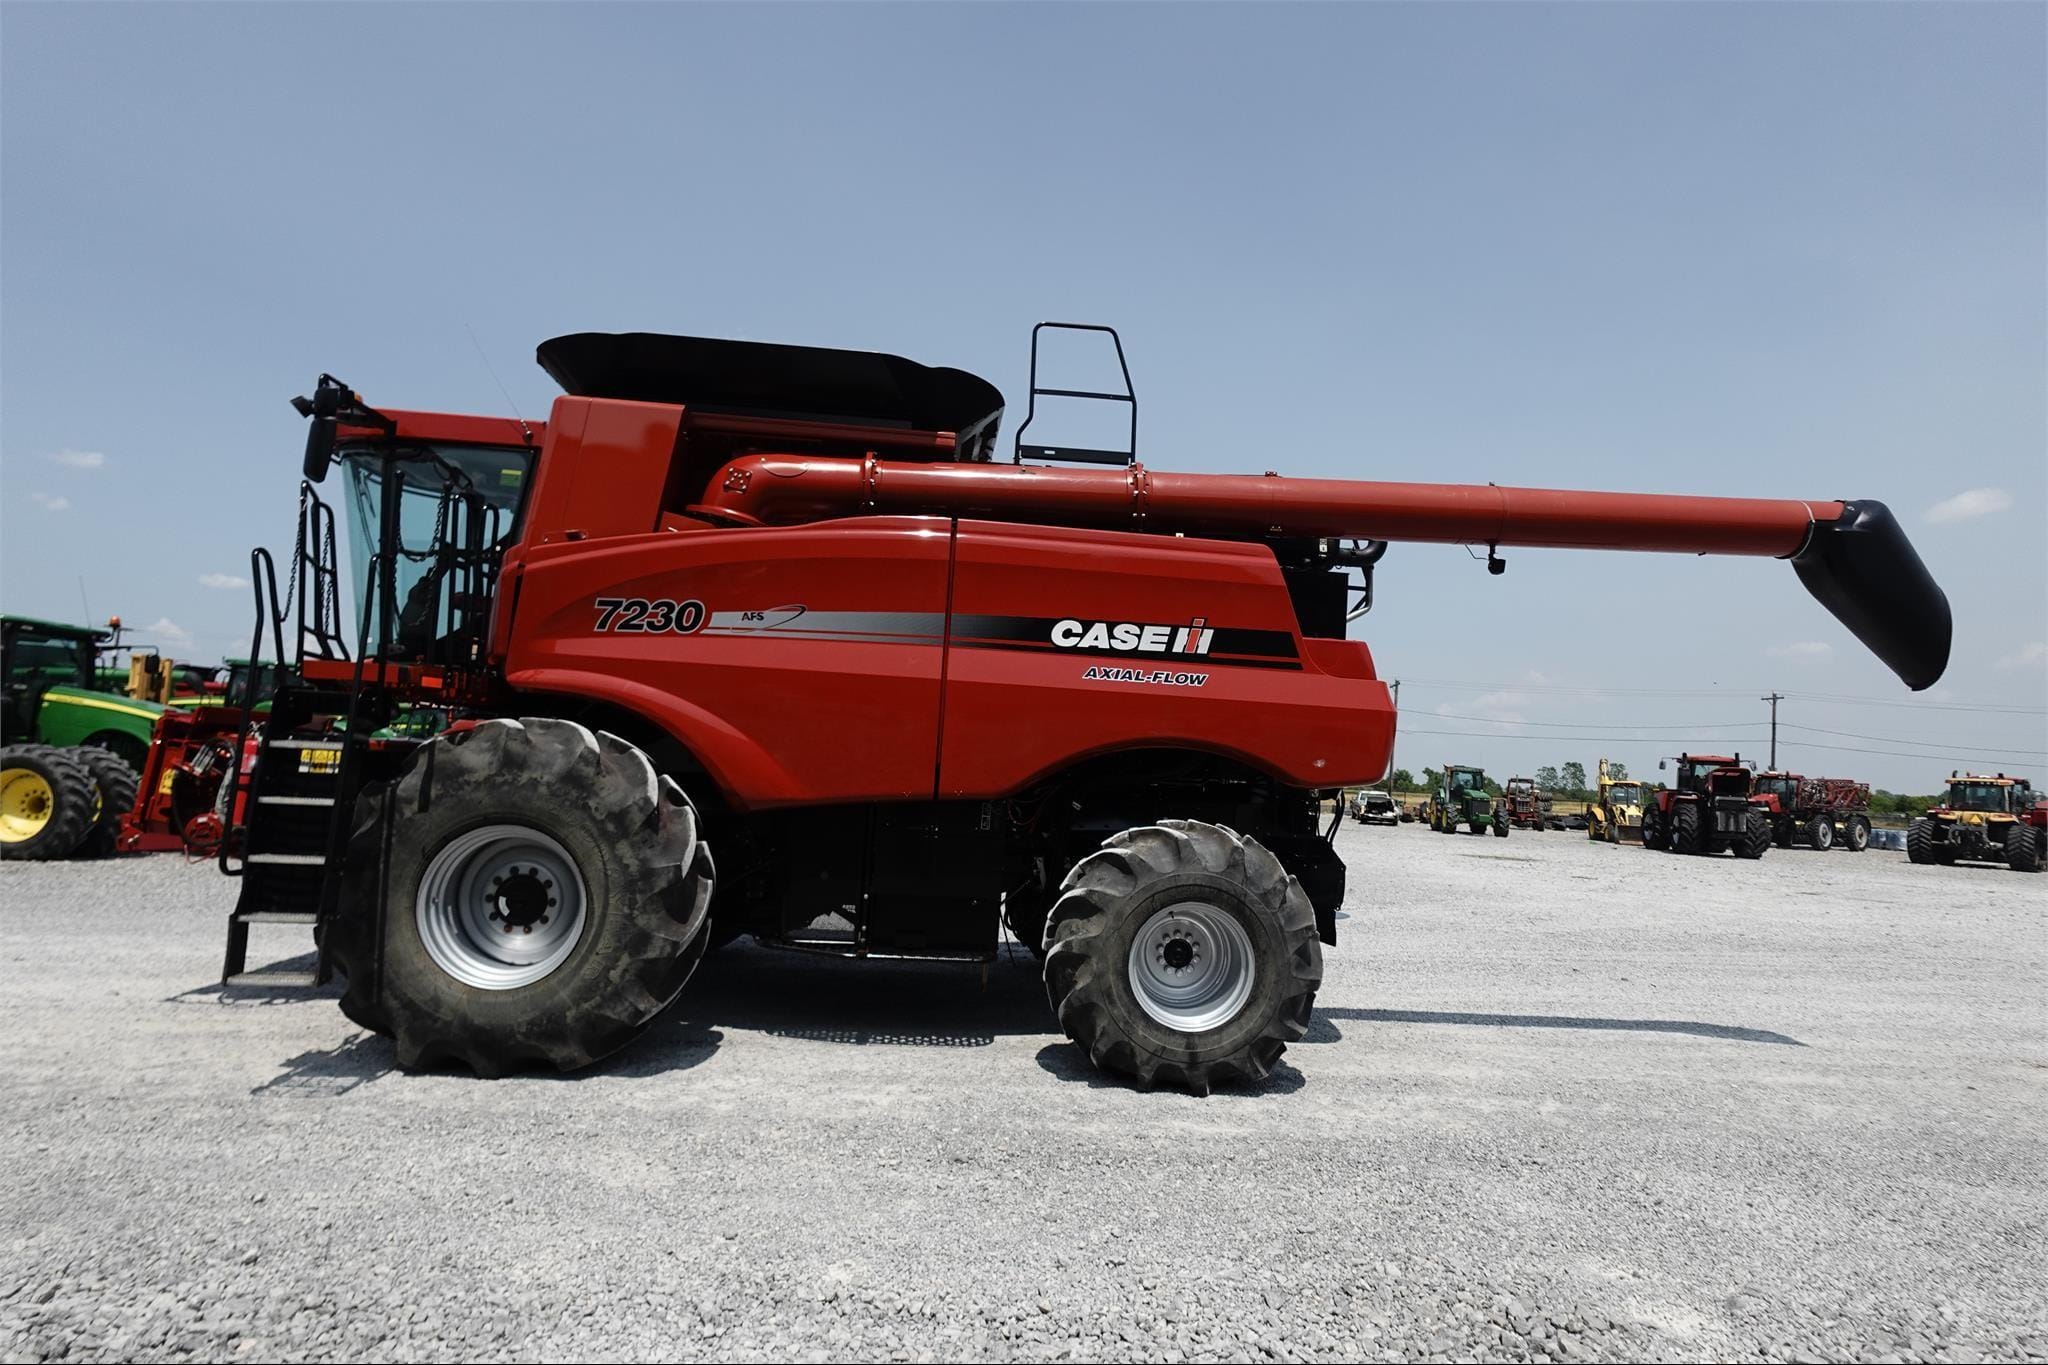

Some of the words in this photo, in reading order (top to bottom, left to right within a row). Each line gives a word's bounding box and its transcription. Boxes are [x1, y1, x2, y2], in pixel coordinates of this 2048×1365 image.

[594, 598, 706, 634] 7230
[741, 611, 765, 622] AFS
[1050, 619, 1172, 652] CASE
[1082, 666, 1209, 687] AXIAL-FLOW
